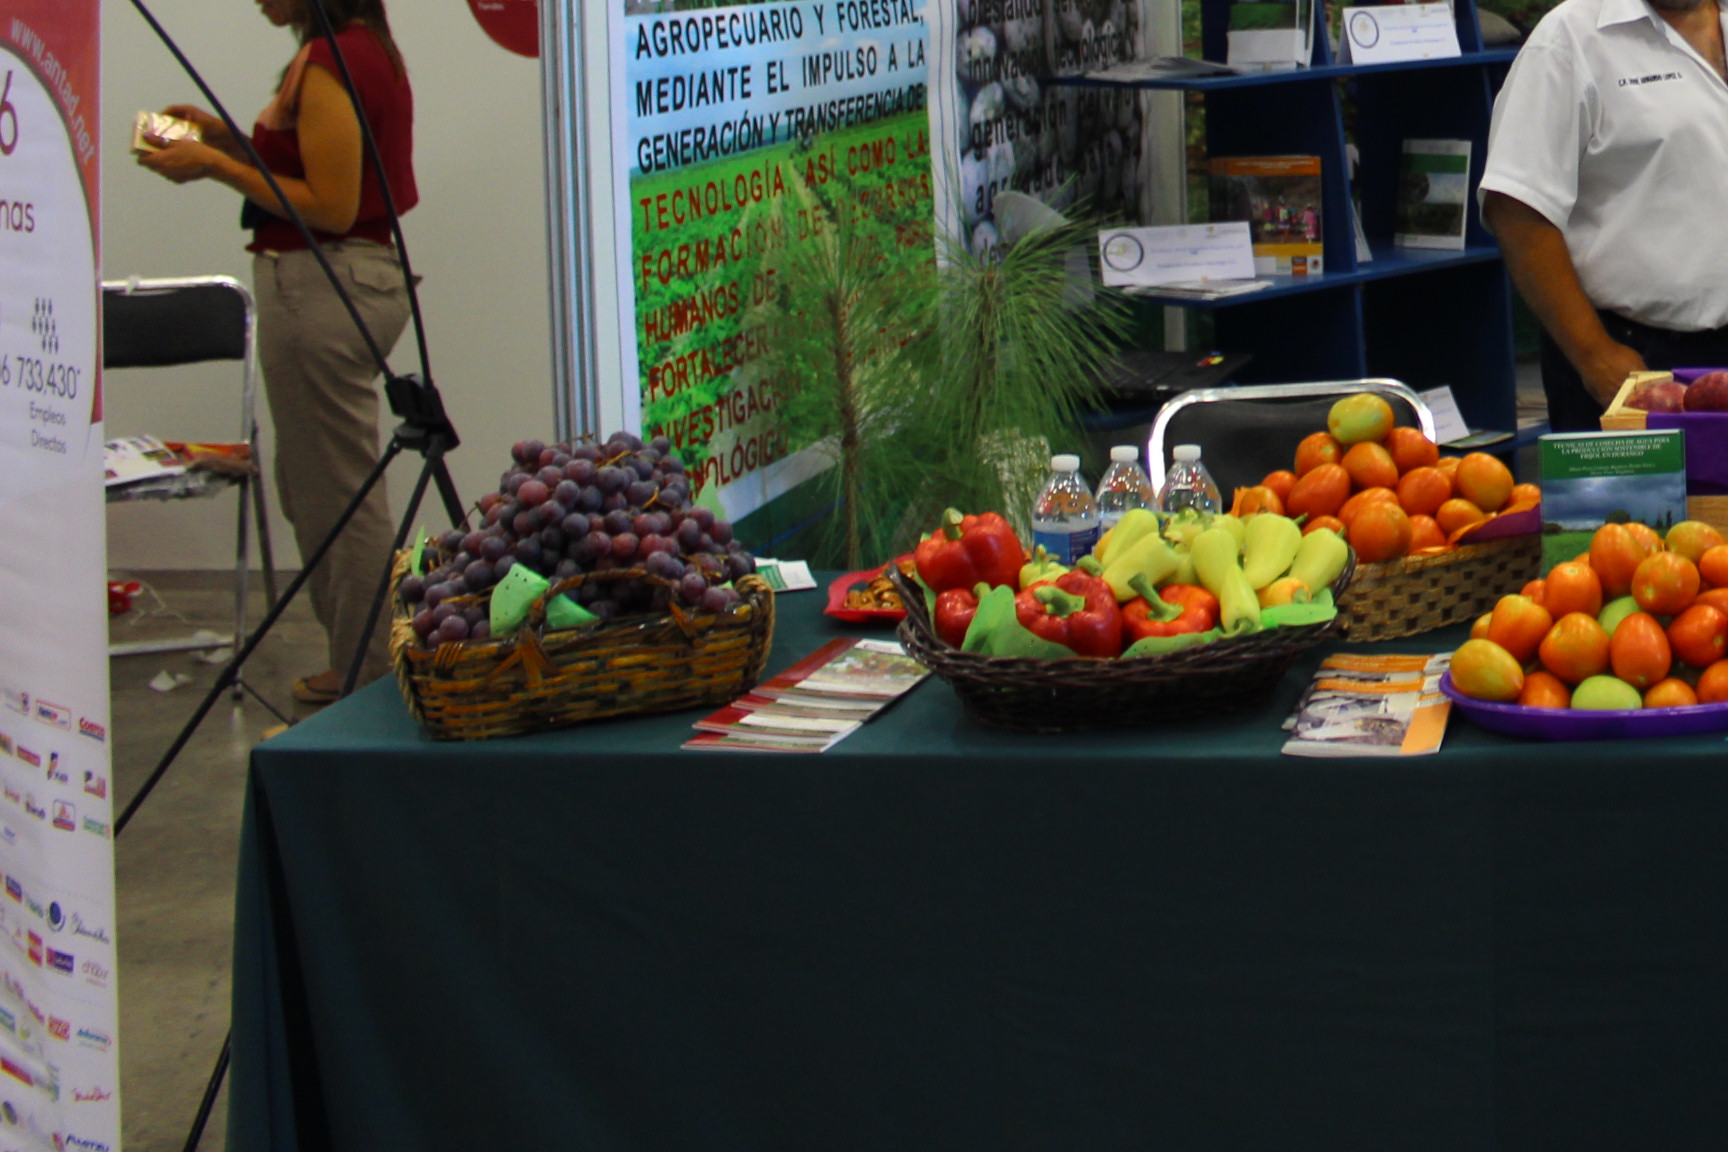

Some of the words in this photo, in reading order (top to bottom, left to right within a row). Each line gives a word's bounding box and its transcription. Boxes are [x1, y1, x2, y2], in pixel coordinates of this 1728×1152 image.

[636, 5, 803, 60] AGROPECUARIO
[814, 4, 825, 36] Y
[11, 17, 95, 165] www.antad.net
[636, 65, 752, 118] MEDIANTE
[767, 60, 789, 95] EL
[803, 45, 877, 88] IMPULSO
[888, 43, 898, 73] A
[908, 39, 925, 69] LA
[637, 110, 763, 175] GENERACIÓN
[768, 113, 780, 145] Y
[785, 86, 905, 141] TRANSFERENCIA
[904, 82, 924, 113] DE
[640, 159, 792, 235] TECNOLOGÍA,
[805, 143, 835, 188] ASÍ
[849, 137, 896, 177] COMO
[906, 129, 930, 160] LA
[641, 215, 782, 291] FORMACIÓN
[798, 204, 824, 241] DE
[645, 280, 739, 347] HUMANOS
[649, 325, 769, 403] FORTALECER
[30, 401, 66, 425] Empleos
[31, 429, 66, 454] Directos
